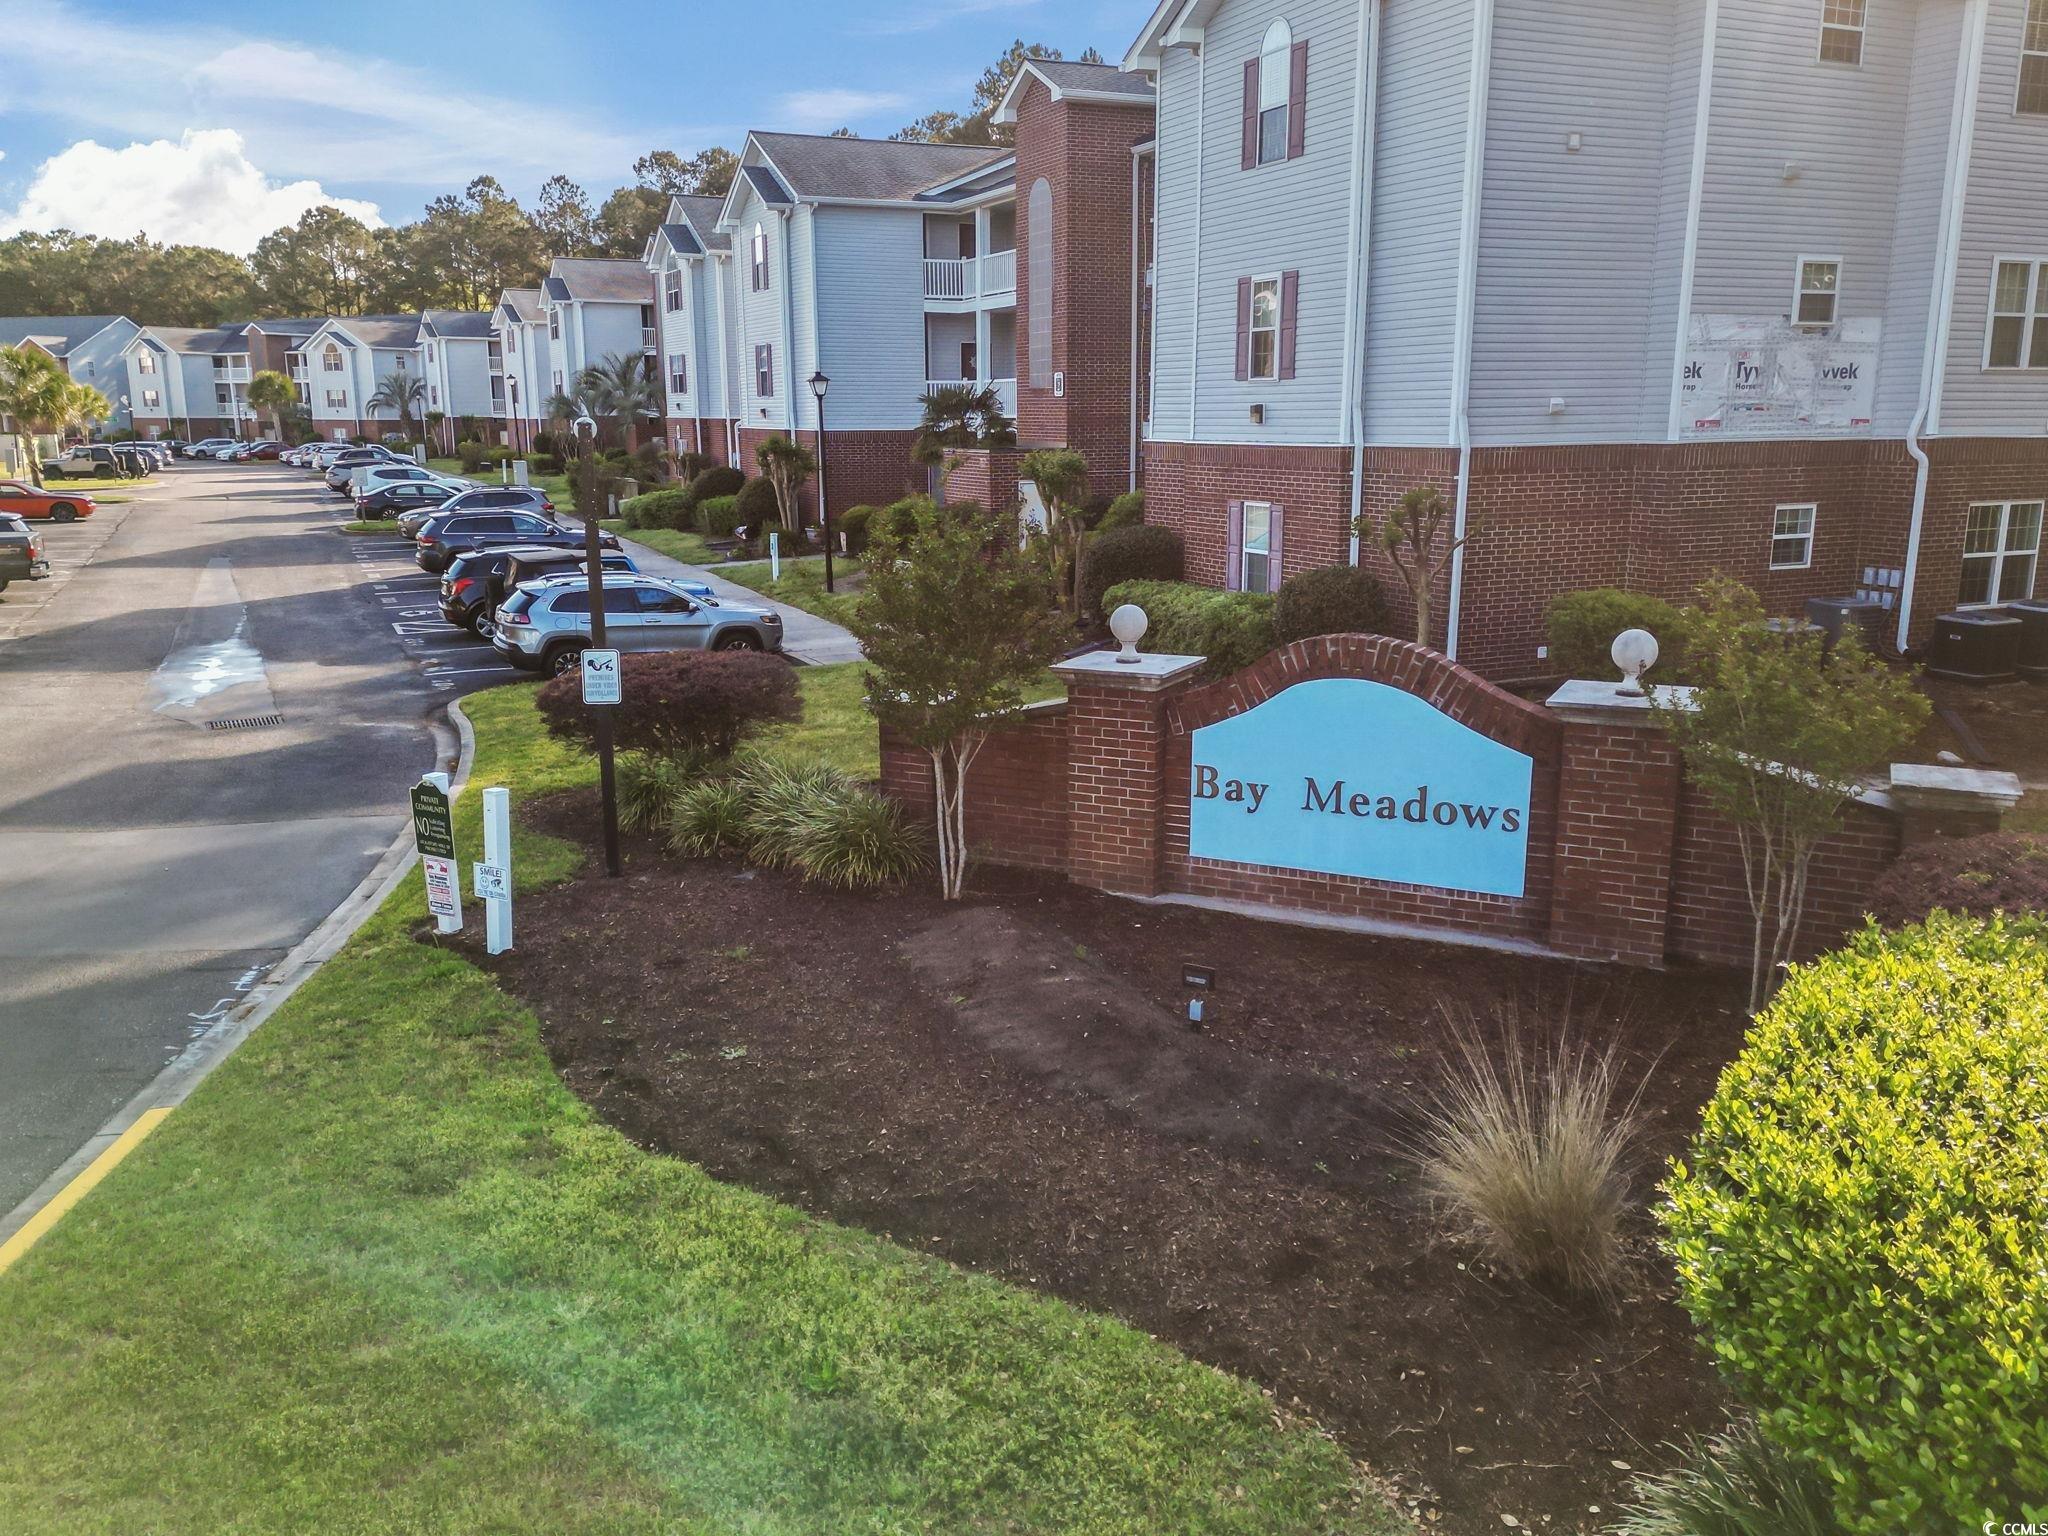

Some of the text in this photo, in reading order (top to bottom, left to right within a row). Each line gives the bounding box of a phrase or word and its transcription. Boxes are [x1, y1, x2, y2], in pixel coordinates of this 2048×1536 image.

[1193, 763, 1521, 833] Bay Meadows
[415, 815, 430, 836] NO
